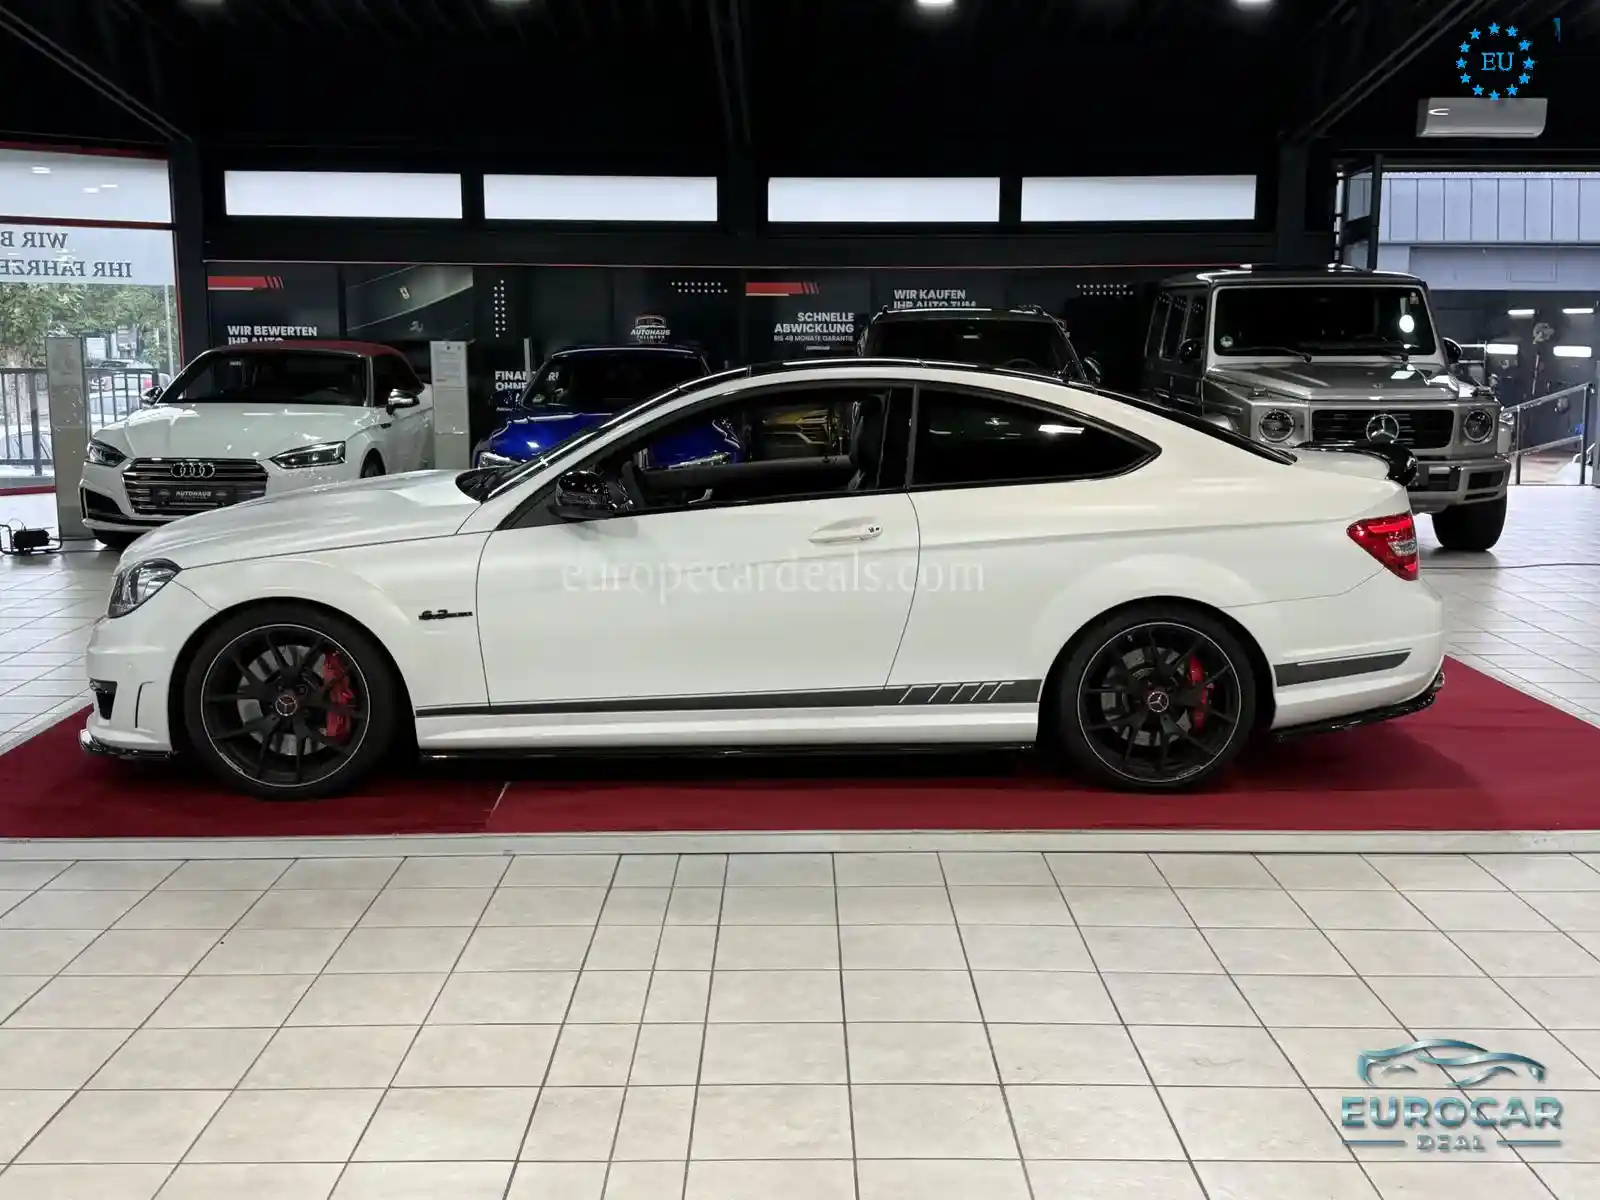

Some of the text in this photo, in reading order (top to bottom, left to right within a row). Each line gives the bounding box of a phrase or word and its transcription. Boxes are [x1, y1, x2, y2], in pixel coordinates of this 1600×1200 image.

[893, 289, 966, 300] WIR KAUFEN
[797, 312, 855, 322] SCHNELLE
[227, 325, 318, 337] WIR BEWERTEN
[774, 323, 855, 333] ABWICKLUNG
